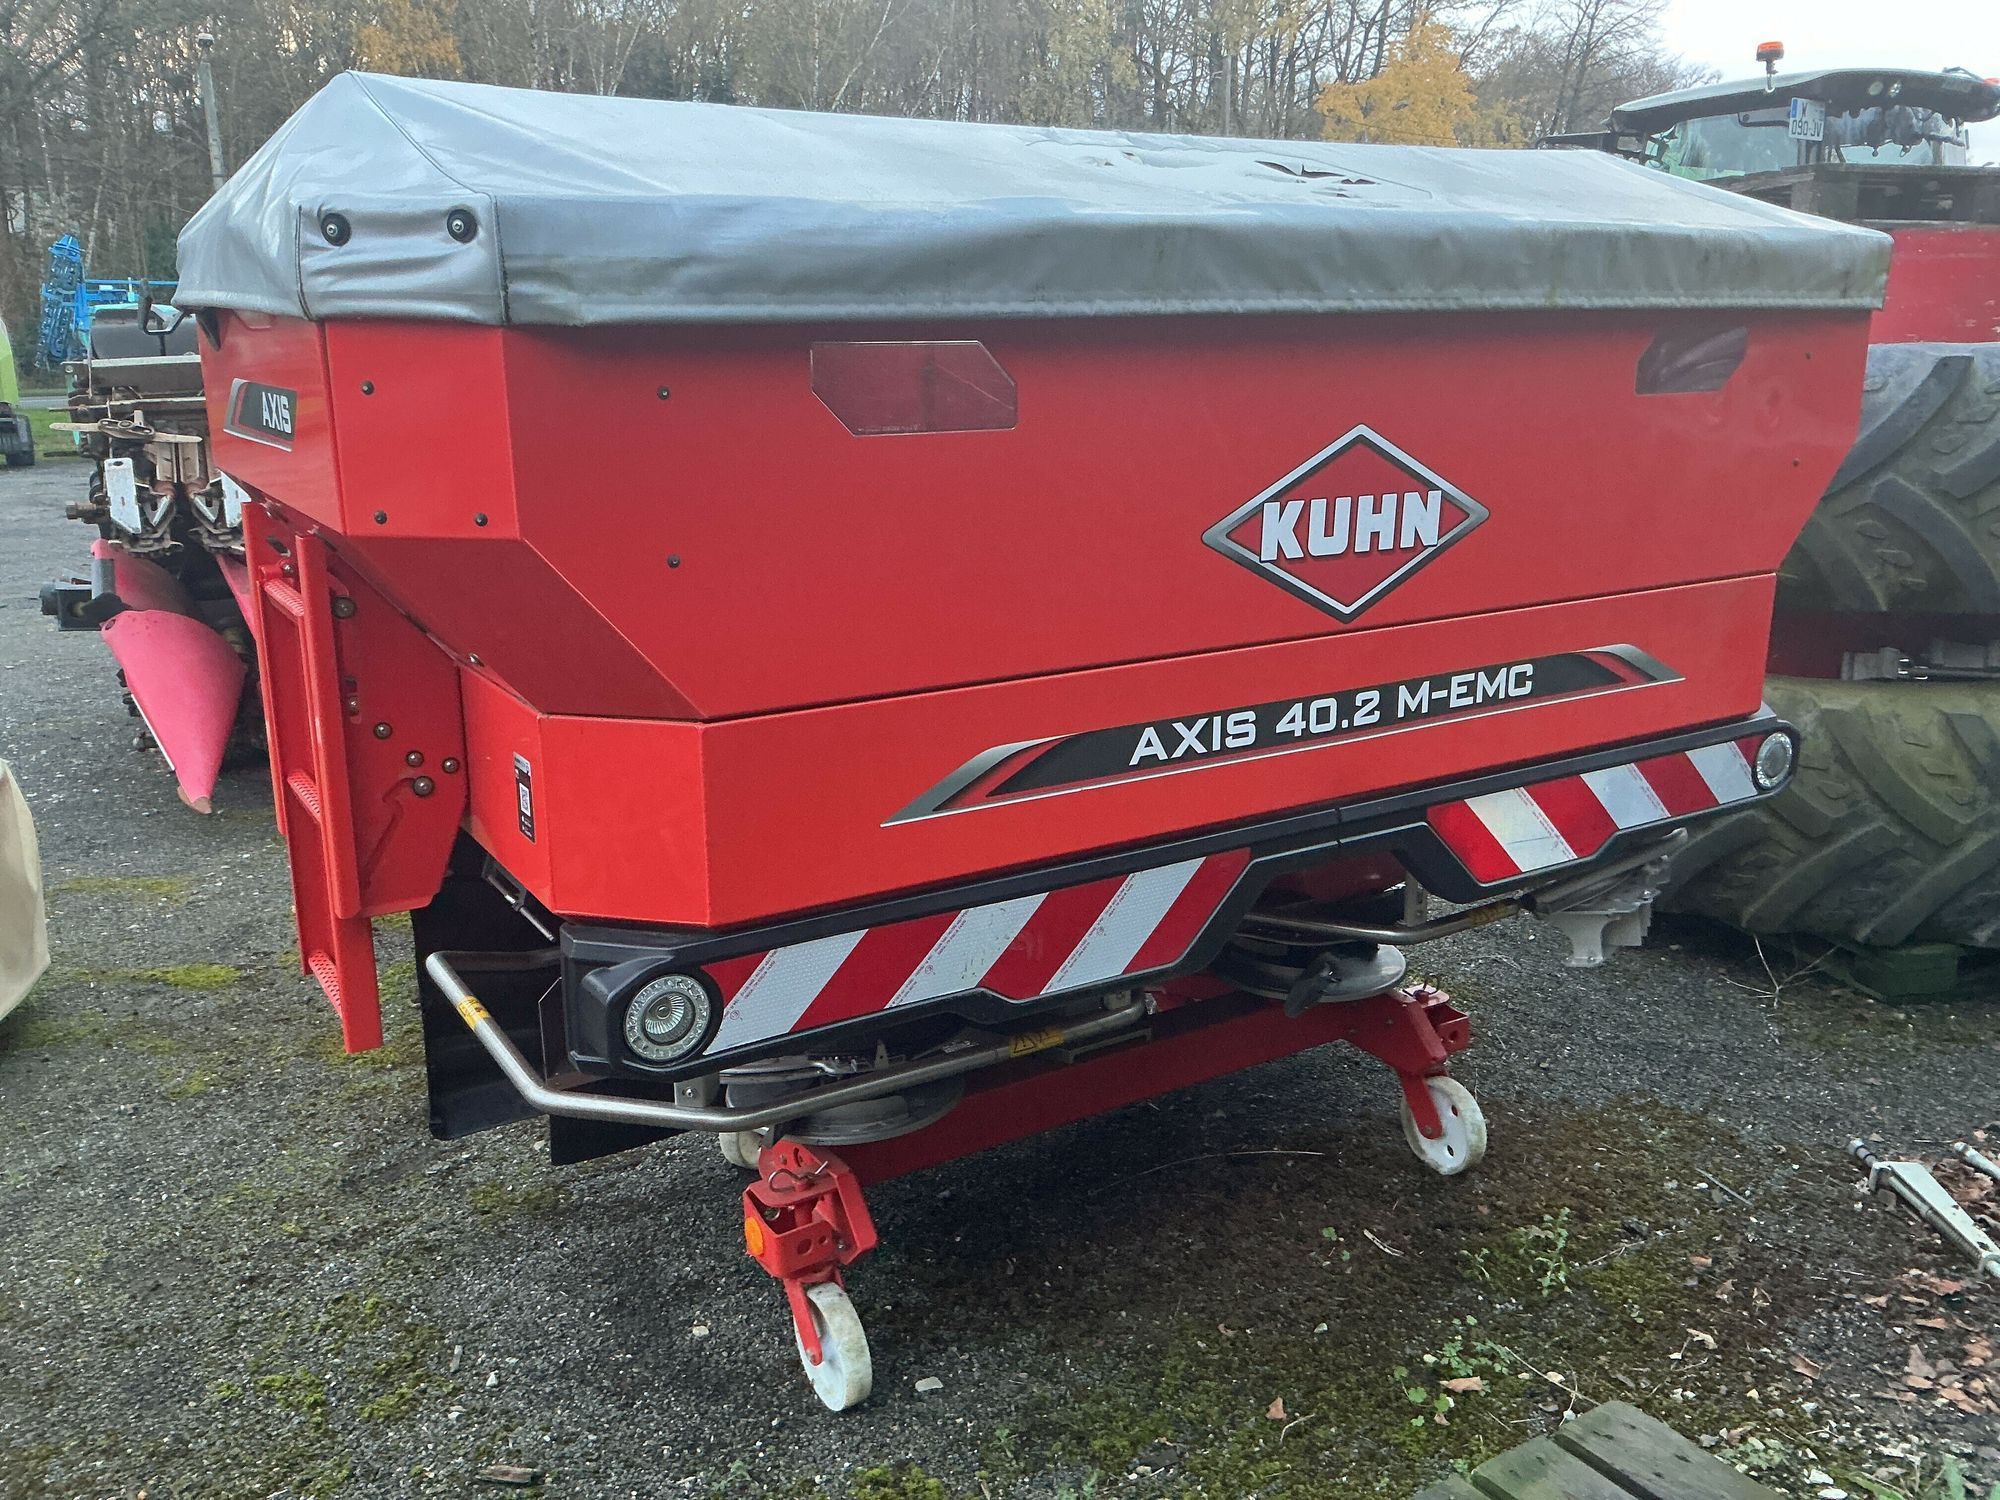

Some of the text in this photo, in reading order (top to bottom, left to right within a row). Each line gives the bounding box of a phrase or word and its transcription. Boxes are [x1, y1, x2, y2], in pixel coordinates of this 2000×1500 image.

[261, 391, 292, 434] AXIS
[1259, 490, 1443, 563] KUHN
[1129, 662, 1534, 766] AXIS 40.2 M-EMC
